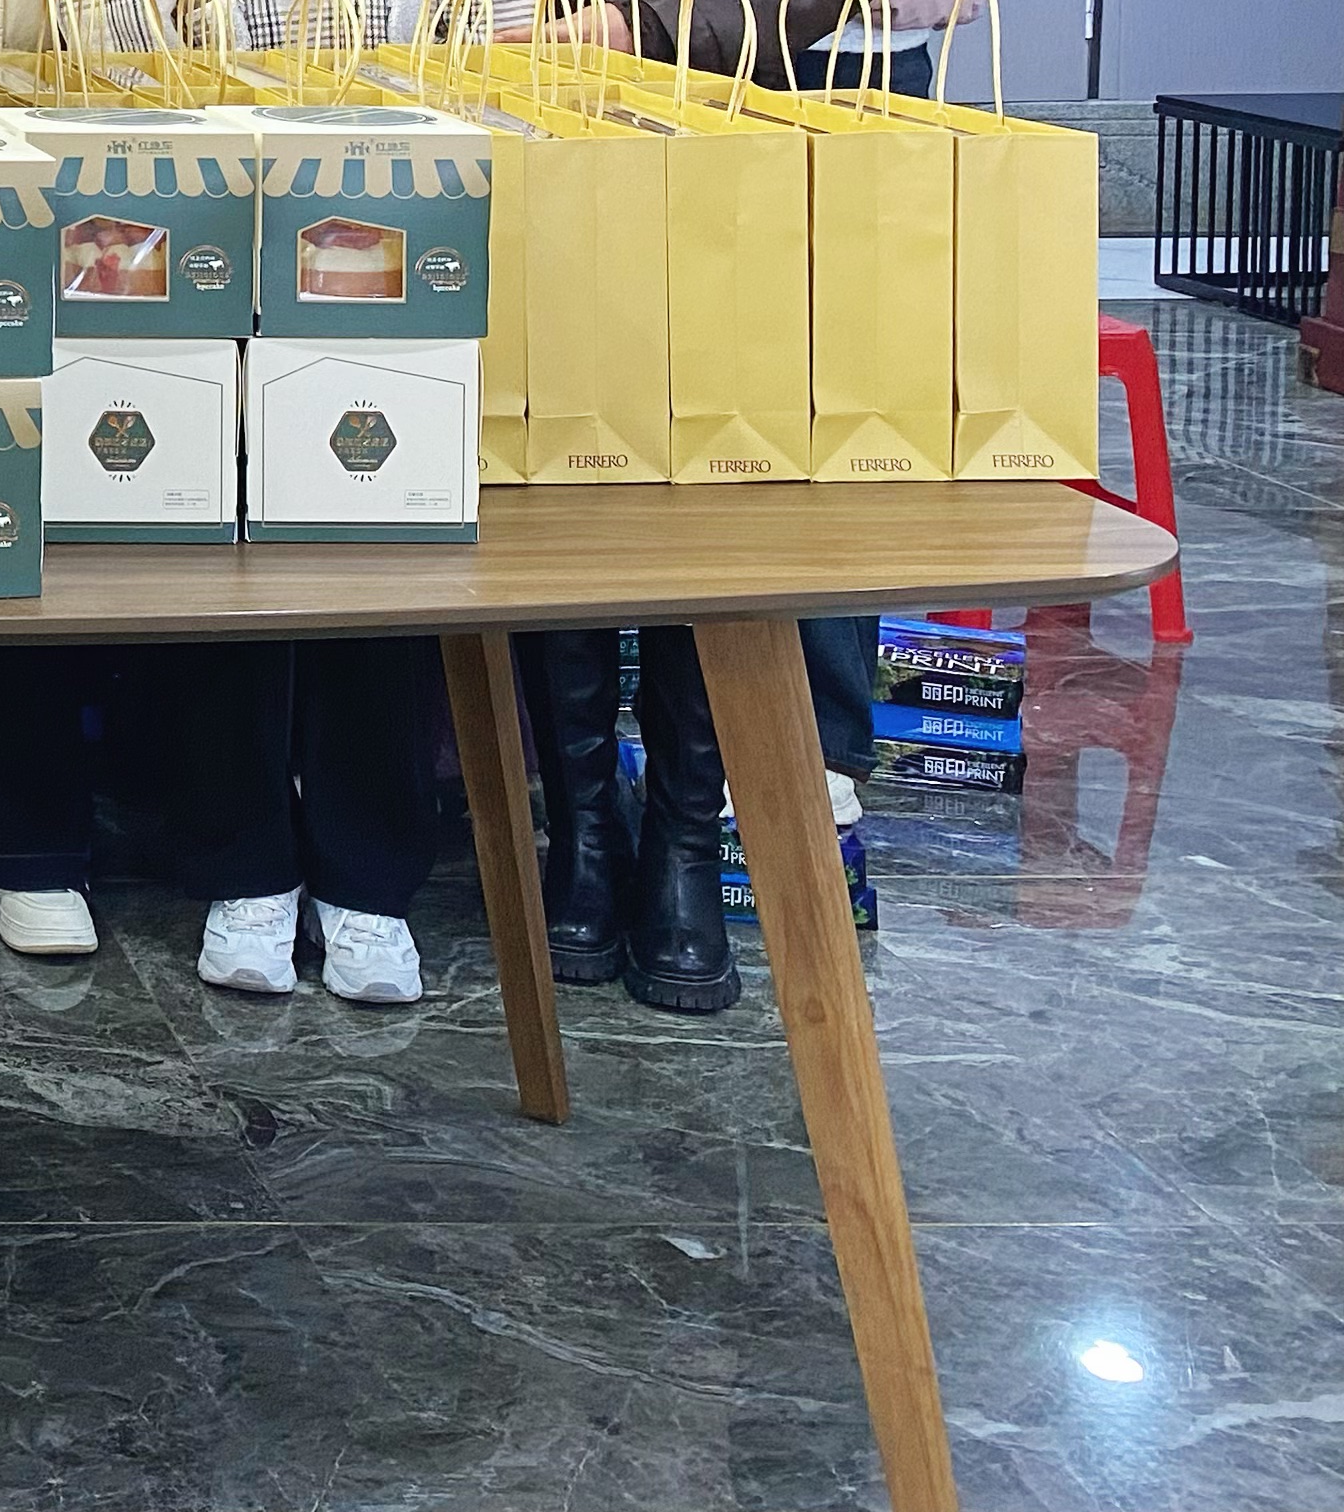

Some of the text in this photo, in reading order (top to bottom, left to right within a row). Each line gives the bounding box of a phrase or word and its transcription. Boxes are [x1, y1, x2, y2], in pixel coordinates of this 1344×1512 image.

[568, 454, 628, 469] FERRERO
[709, 459, 772, 474] FERRERO
[850, 458, 912, 473] FERRERO
[992, 453, 1055, 469] FERRERO
[890, 652, 1005, 674] PRINT
[964, 695, 1004, 710] PRINT
[964, 728, 1004, 741] PRINT
[966, 767, 1006, 782] PRINT
